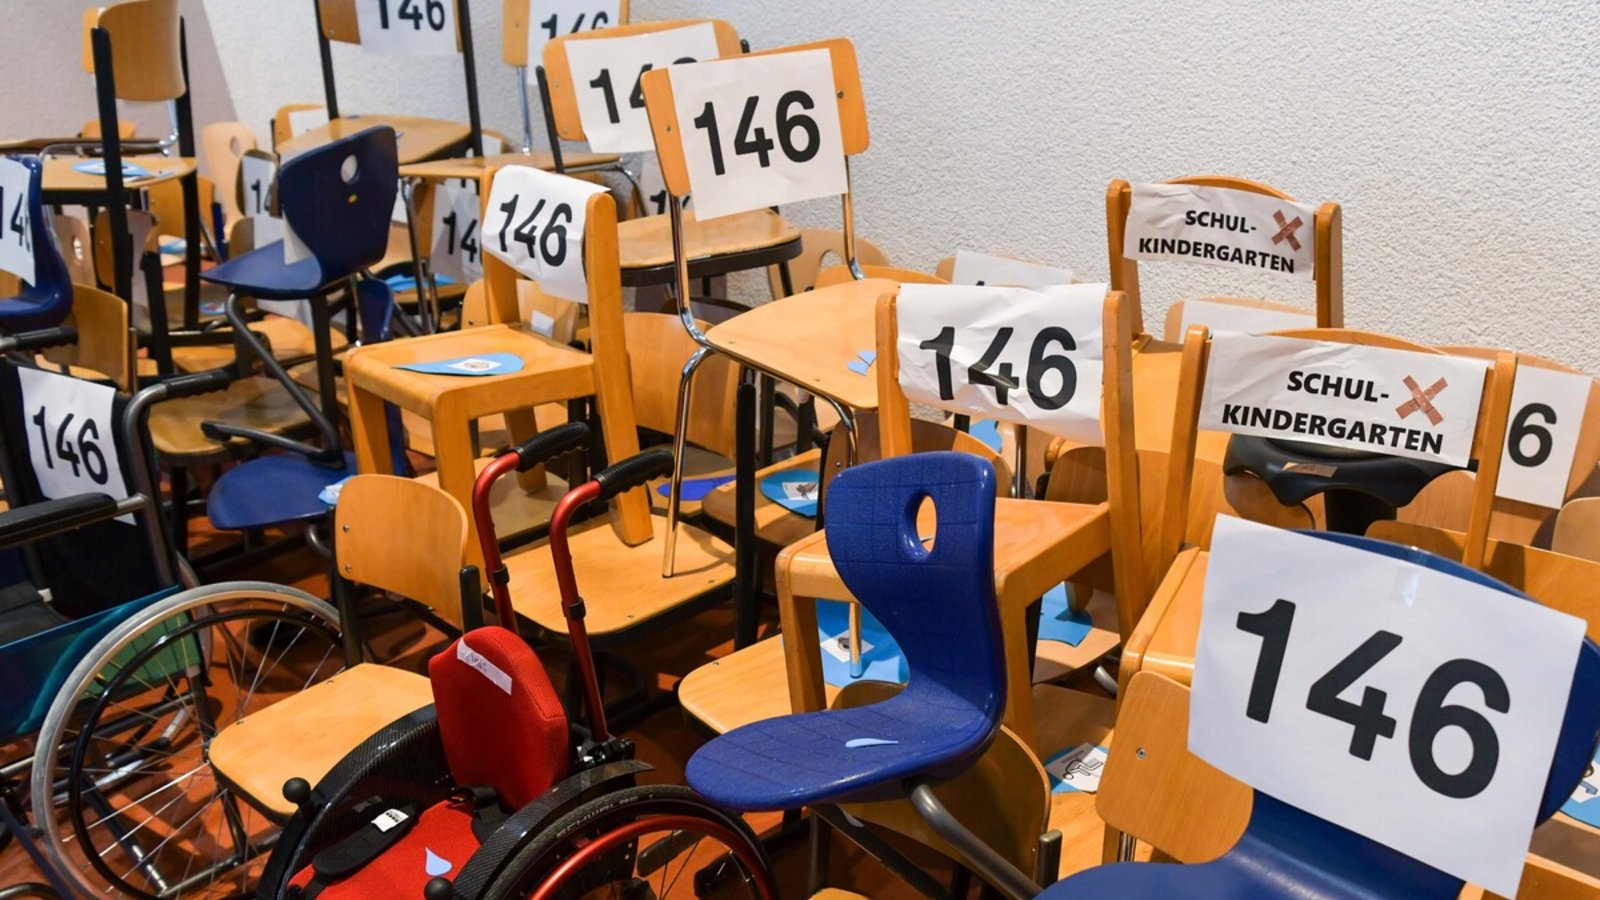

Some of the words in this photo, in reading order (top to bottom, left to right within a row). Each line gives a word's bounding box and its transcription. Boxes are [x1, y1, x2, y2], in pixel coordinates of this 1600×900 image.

[378, 0, 445, 31] 146
[693, 91, 821, 176] 146
[499, 194, 573, 267] 146
[1184, 210, 1257, 234] SCHUL-
[1138, 237, 1295, 274] KINDERGARTEN
[919, 326, 1077, 411] 146
[1287, 370, 1389, 403] SCHUL-
[33, 405, 108, 486] 146
[1221, 404, 1444, 454] KINDERGARTEN
[1507, 402, 1557, 468] 6
[1236, 598, 1511, 799] 146
